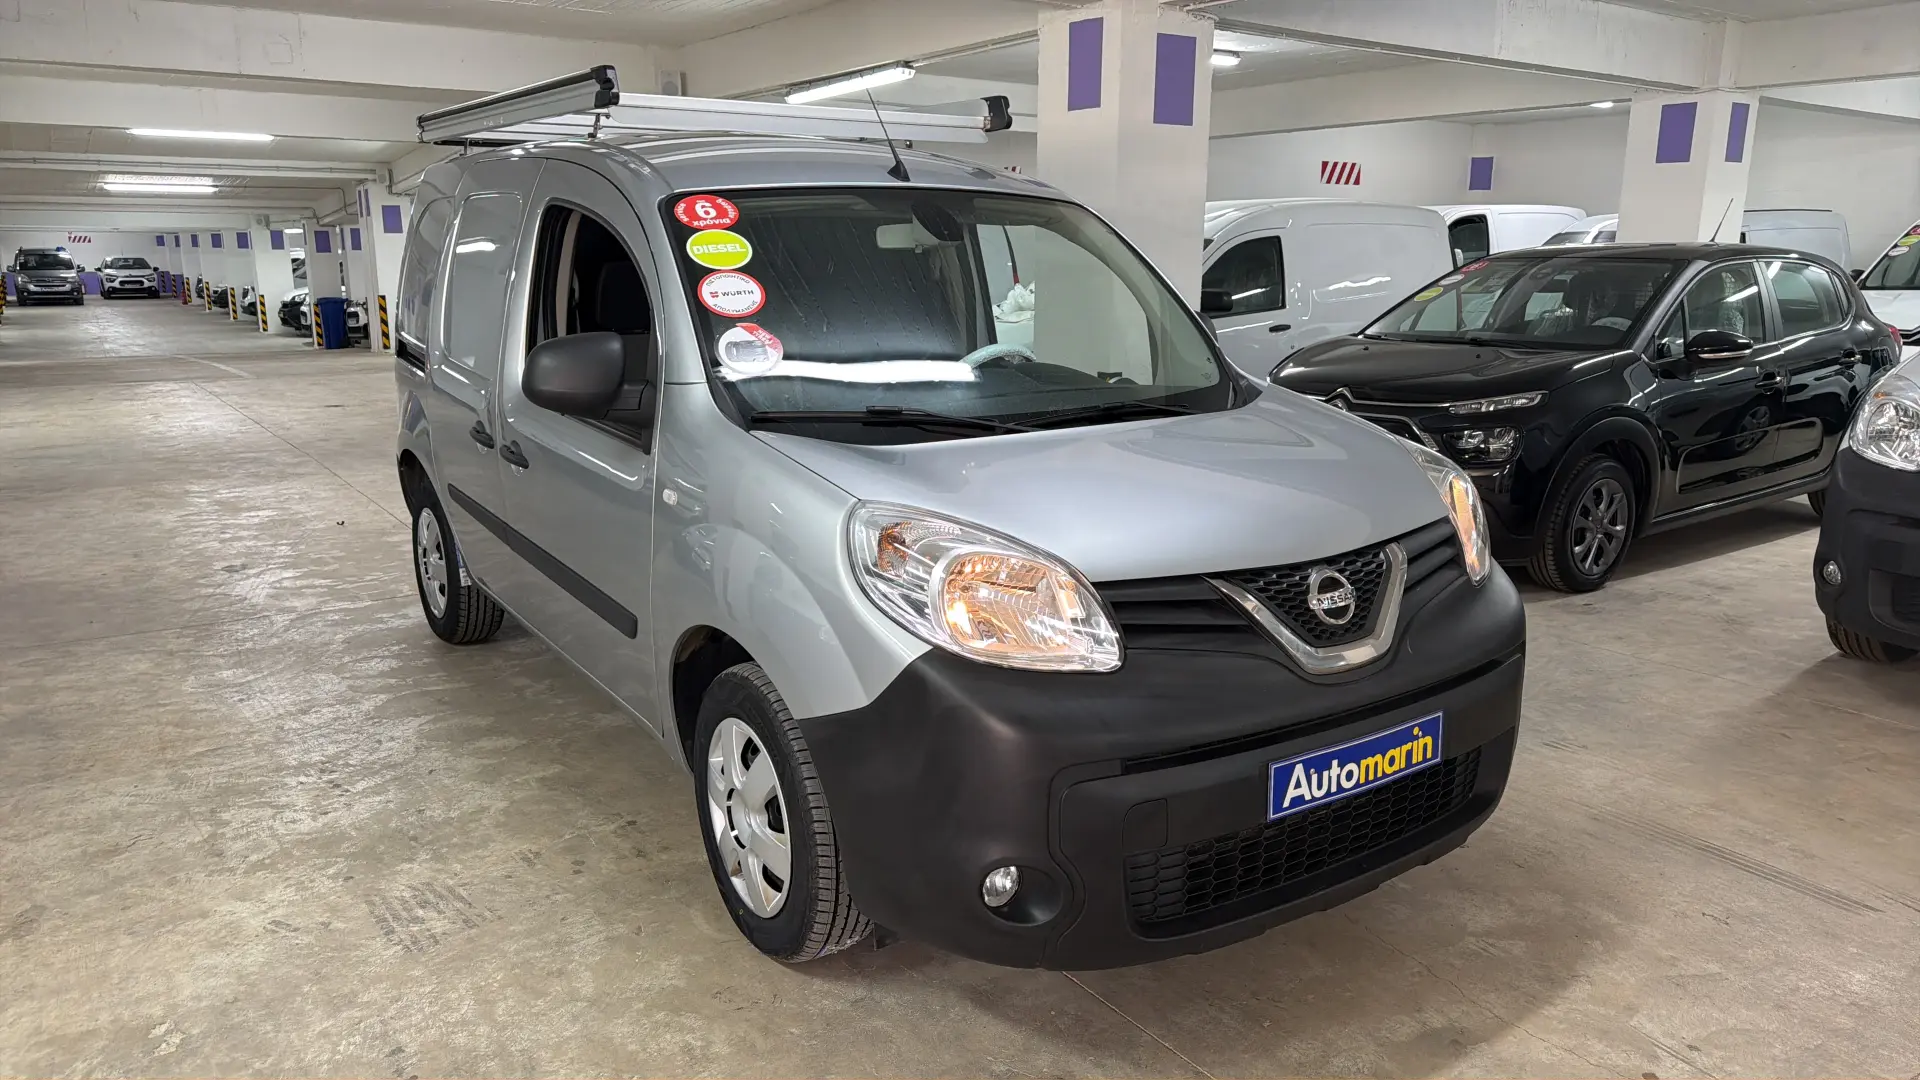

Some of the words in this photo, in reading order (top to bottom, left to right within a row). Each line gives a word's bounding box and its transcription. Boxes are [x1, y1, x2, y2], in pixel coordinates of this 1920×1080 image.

[695, 202, 717, 219] 6
[692, 218, 731, 227] χρόνια
[692, 243, 746, 254] DIESEL
[1316, 591, 1353, 606] NISSAN
[1281, 726, 1433, 809] Automarin
